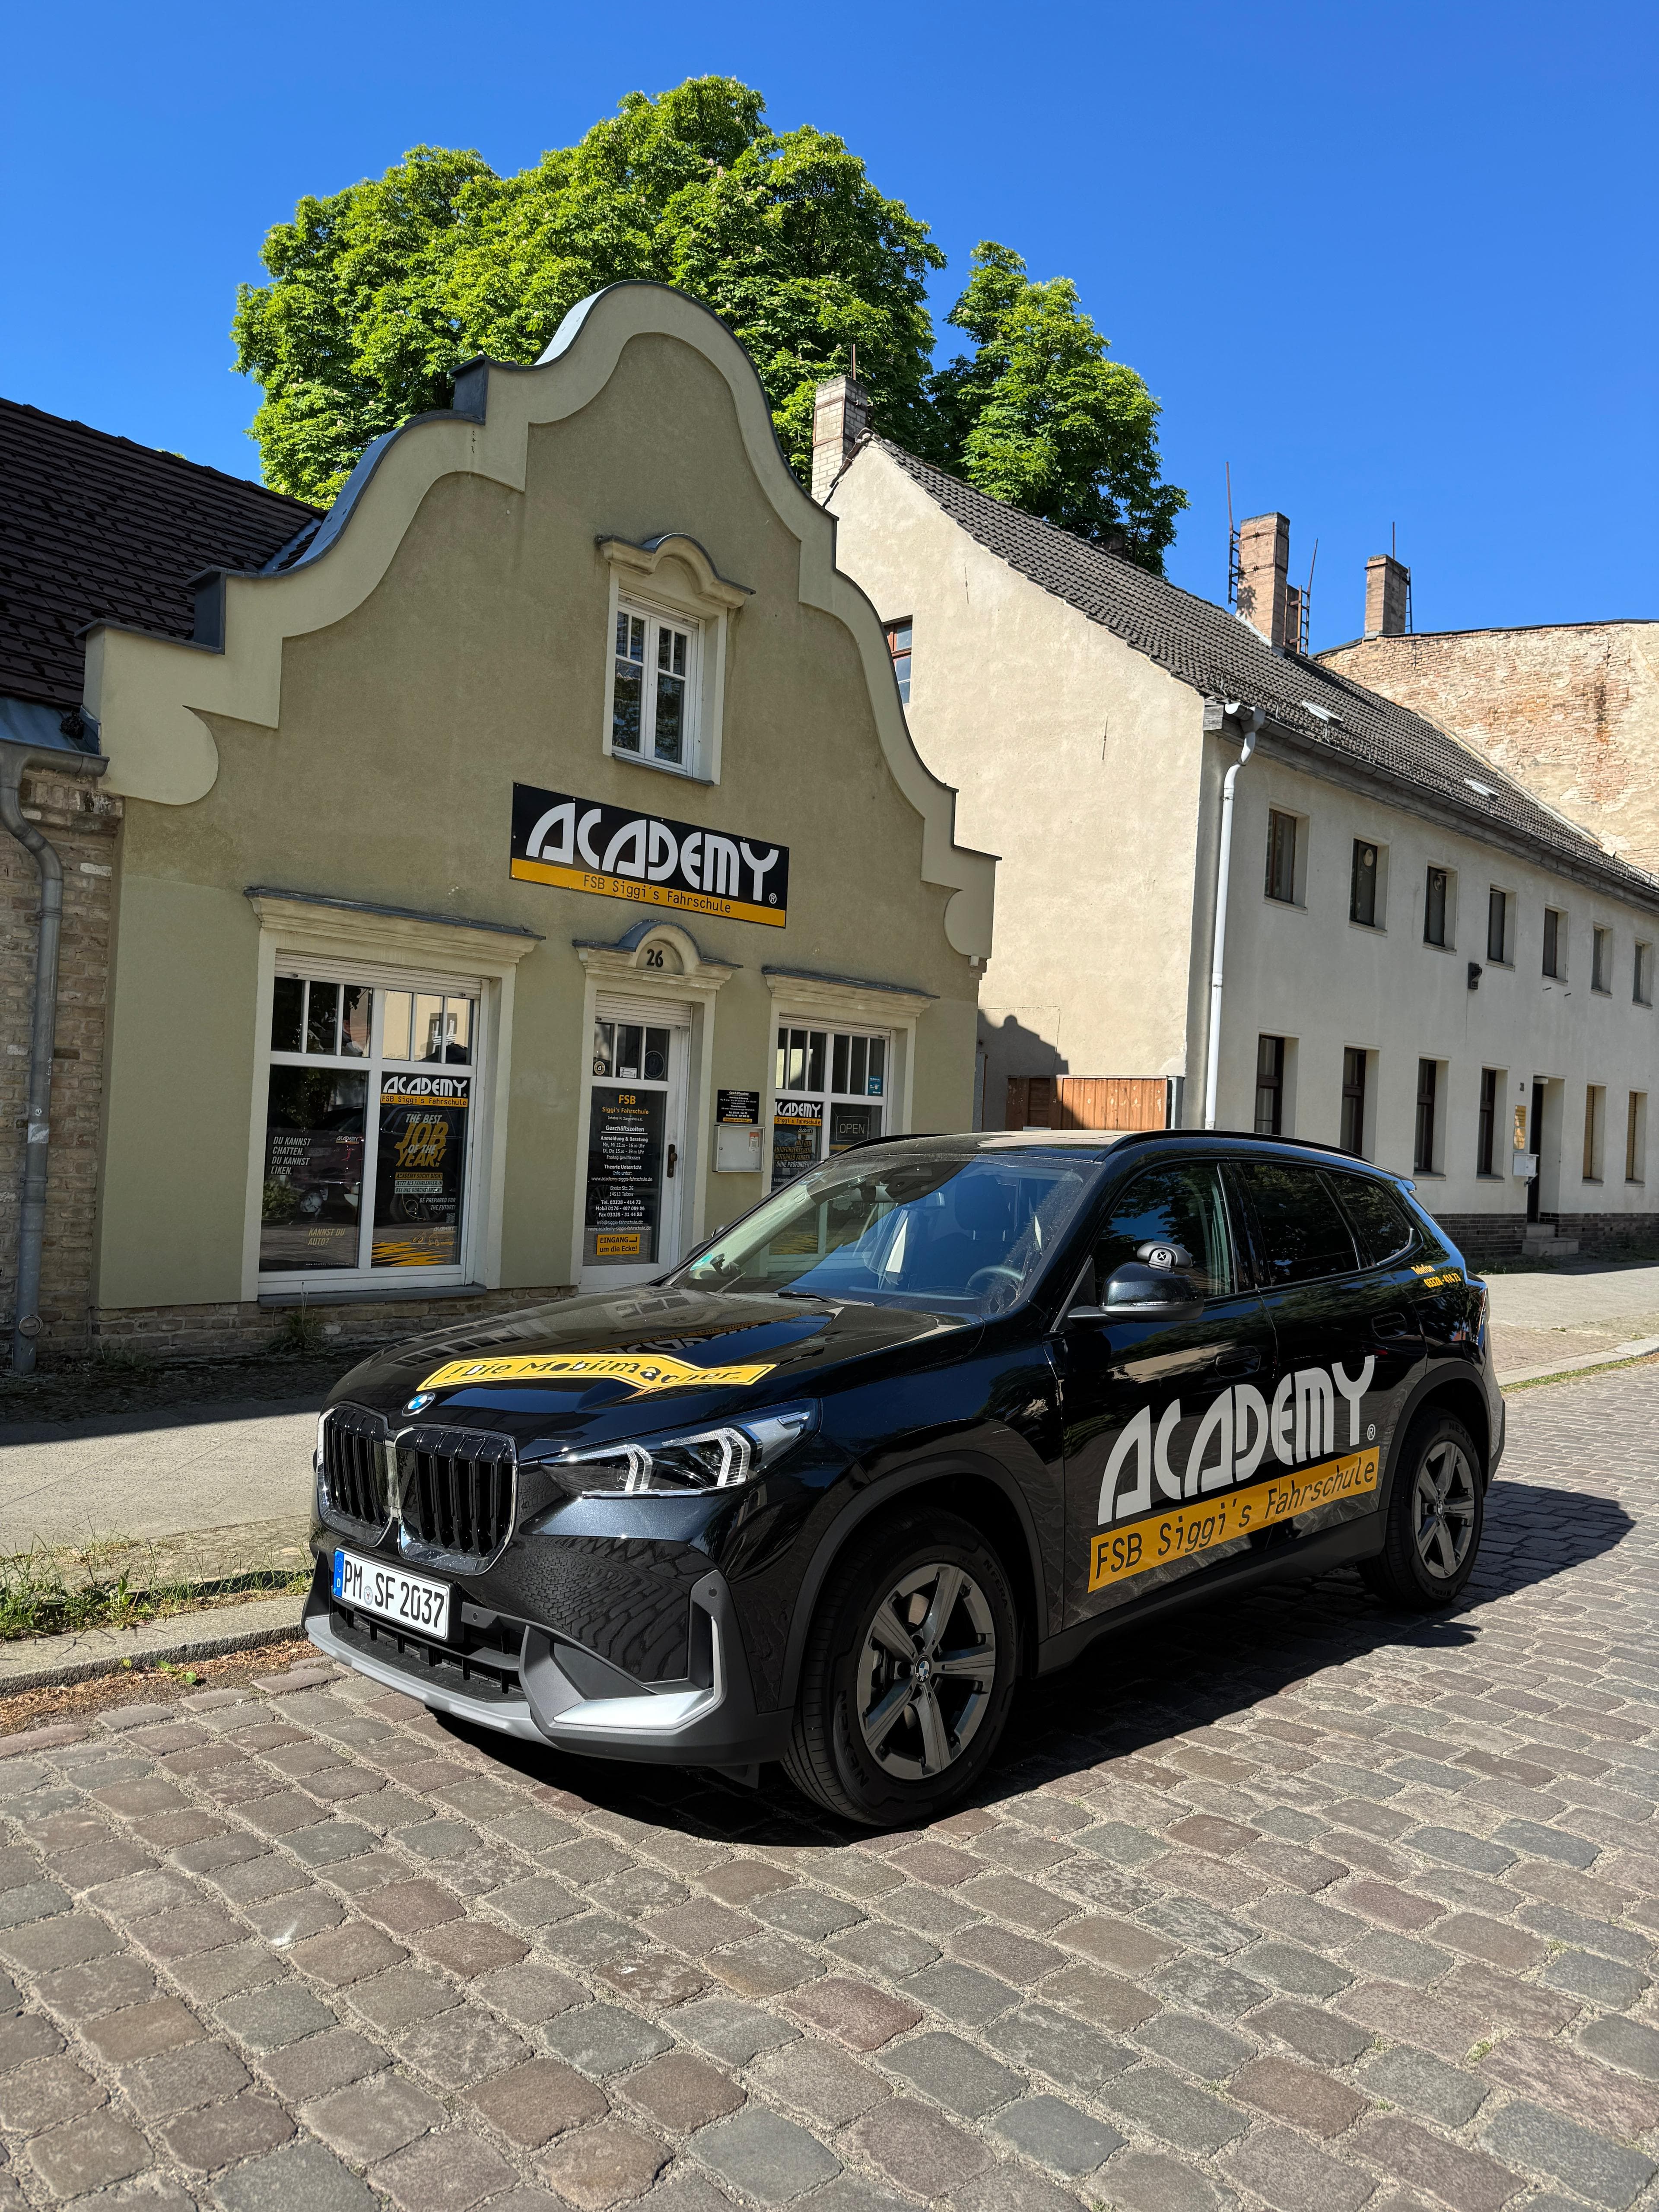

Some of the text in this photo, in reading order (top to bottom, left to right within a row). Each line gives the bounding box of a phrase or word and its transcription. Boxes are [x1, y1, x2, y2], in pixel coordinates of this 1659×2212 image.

[525, 802, 779, 902] ACADEMY
[583, 874, 605, 890] FSB
[667, 891, 731, 914] Fahrschule
[647, 949, 663, 967] 26
[383, 1076, 467, 1096] ACADEMY
[618, 1094, 636, 1105] FSB
[406, 1113, 442, 1125] THE BEST
[839, 1123, 864, 1134] OPEN
[273, 1136, 311, 1146] DU KANNST
[394, 1121, 449, 1150] JOB
[272, 1146, 304, 1156] CHATTEN.
[407, 1144, 437, 1154] OF THE
[272, 1156, 310, 1166] DU KANNST
[395, 1147, 447, 1167] YEAR!
[270, 1166, 292, 1175] LIKEN.
[308, 1228, 335, 1236] KANNST
[308, 1237, 330, 1246] AUTO?
[1411, 1264, 1435, 1275] Telefon
[1424, 1276, 1443, 1288] 03328
[1098, 1355, 1375, 1526] ACADEMY
[1095, 1532, 1143, 1579] FSB
[1264, 1460, 1374, 1519] Fahrschule
[337, 1577, 340, 1588] D
[344, 1560, 444, 1628] PM SF 2037
